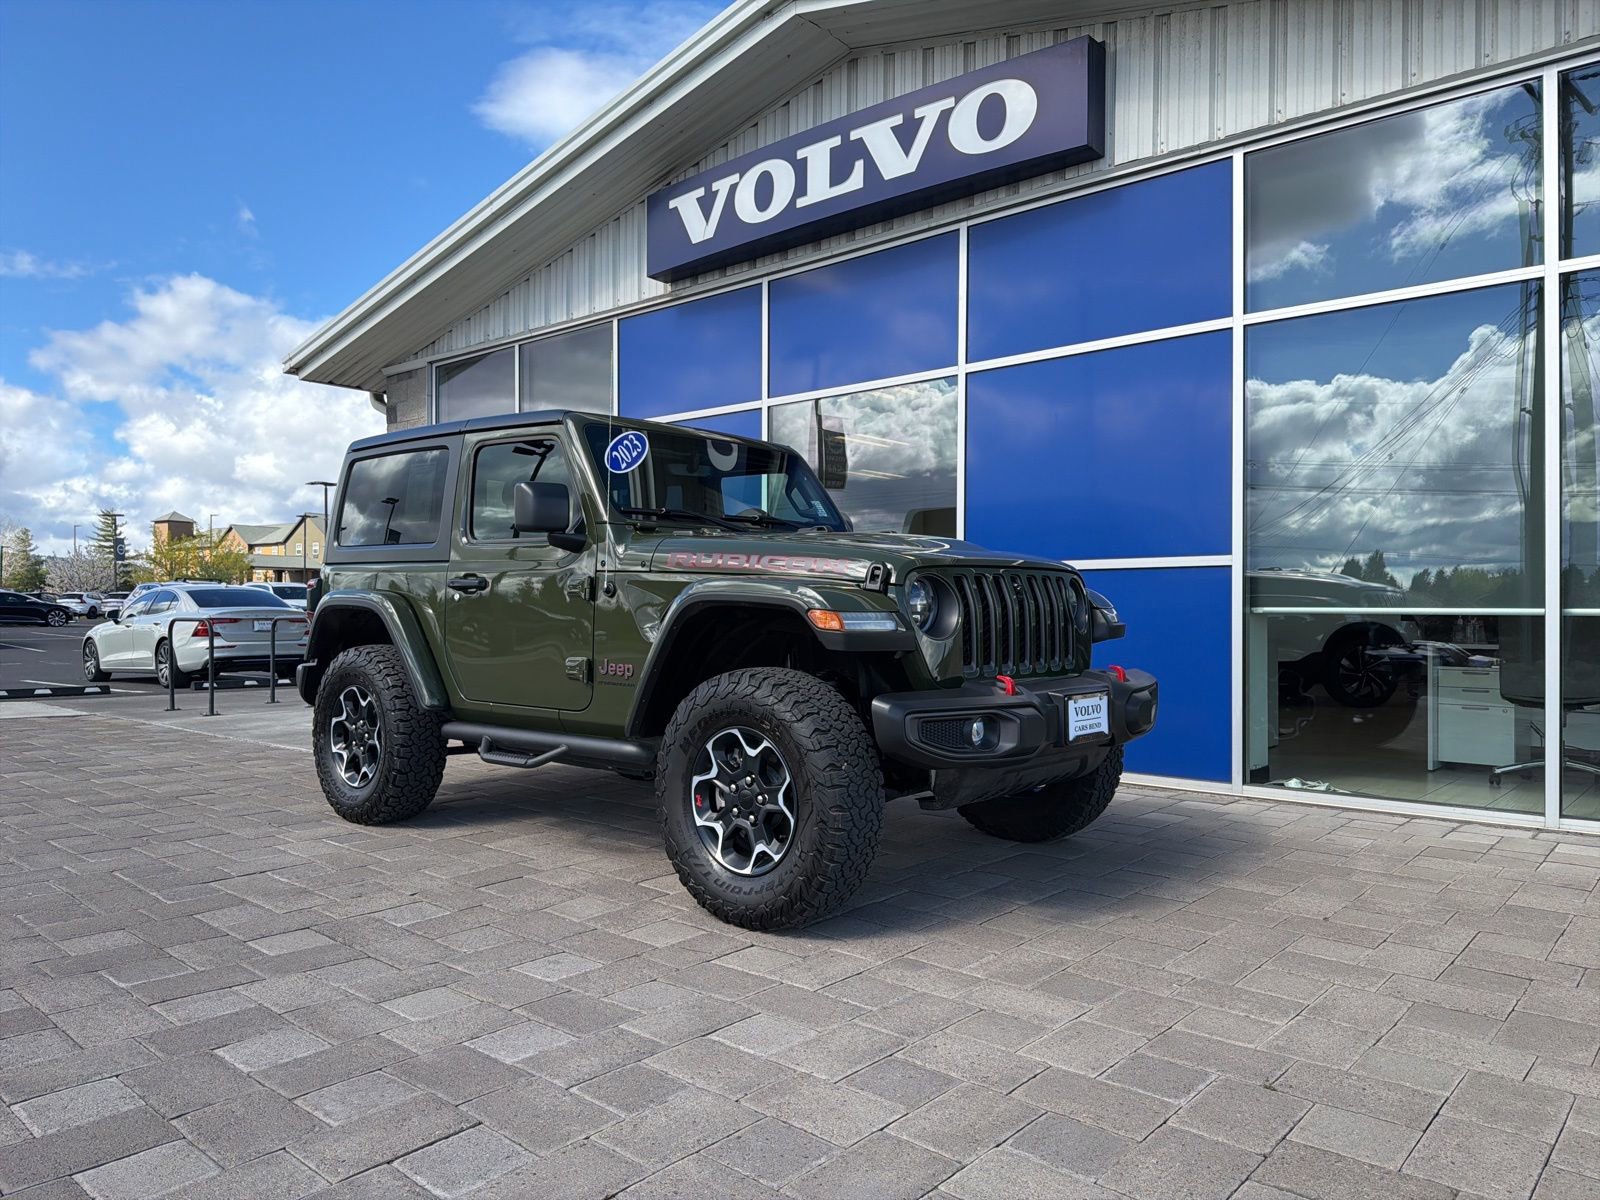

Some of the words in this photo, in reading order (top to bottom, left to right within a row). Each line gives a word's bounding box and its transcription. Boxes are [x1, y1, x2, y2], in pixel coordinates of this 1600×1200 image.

[668, 78, 1038, 244] VOLVO
[611, 434, 643, 470] 2023
[666, 552, 849, 574] RUBICON
[598, 658, 634, 680] Jeep
[1074, 703, 1102, 717] VOLVO
[1074, 723, 1088, 732] CARS
[1089, 722, 1102, 730] BEND
